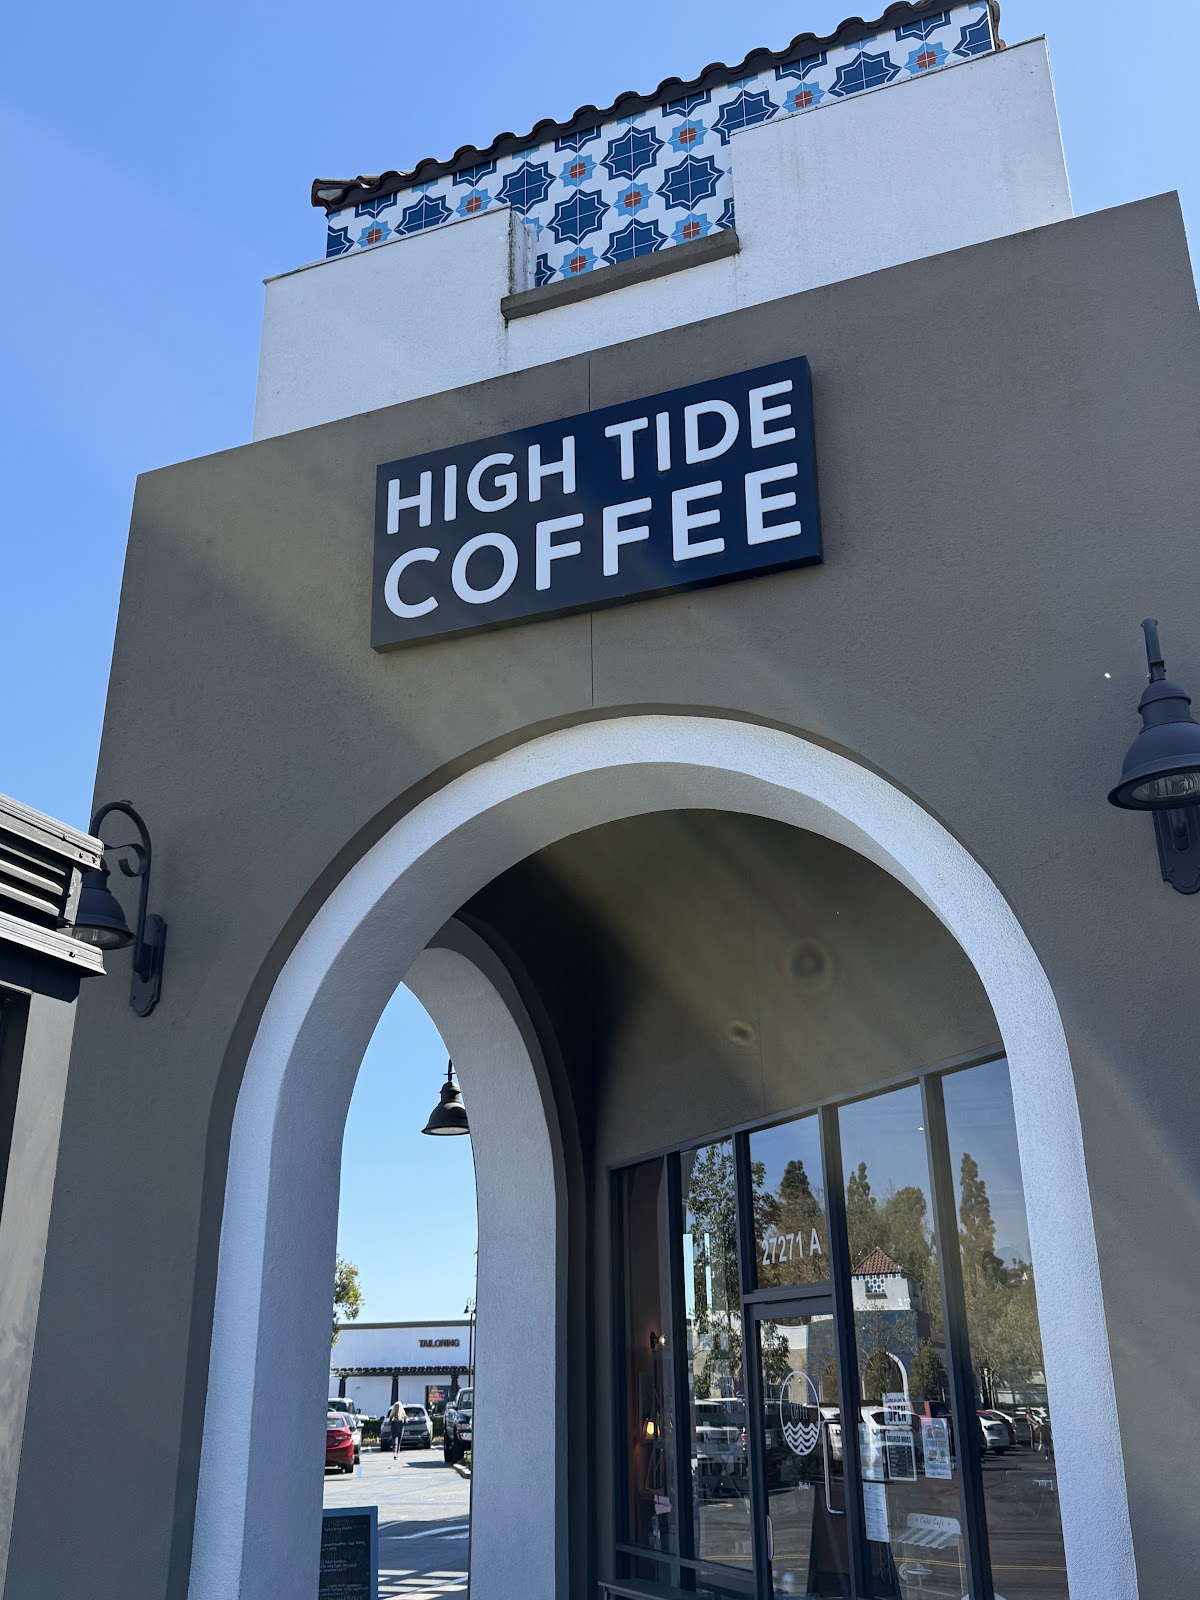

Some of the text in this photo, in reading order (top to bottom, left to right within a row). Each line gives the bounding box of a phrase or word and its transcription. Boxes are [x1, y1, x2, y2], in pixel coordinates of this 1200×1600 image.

[386, 379, 796, 535] HIGH TIDE
[384, 462, 802, 619] COFFEE
[761, 1227, 822, 1265] 27271 A
[418, 1338, 460, 1348] TAILORING
[888, 1405, 907, 1422] OPEN
